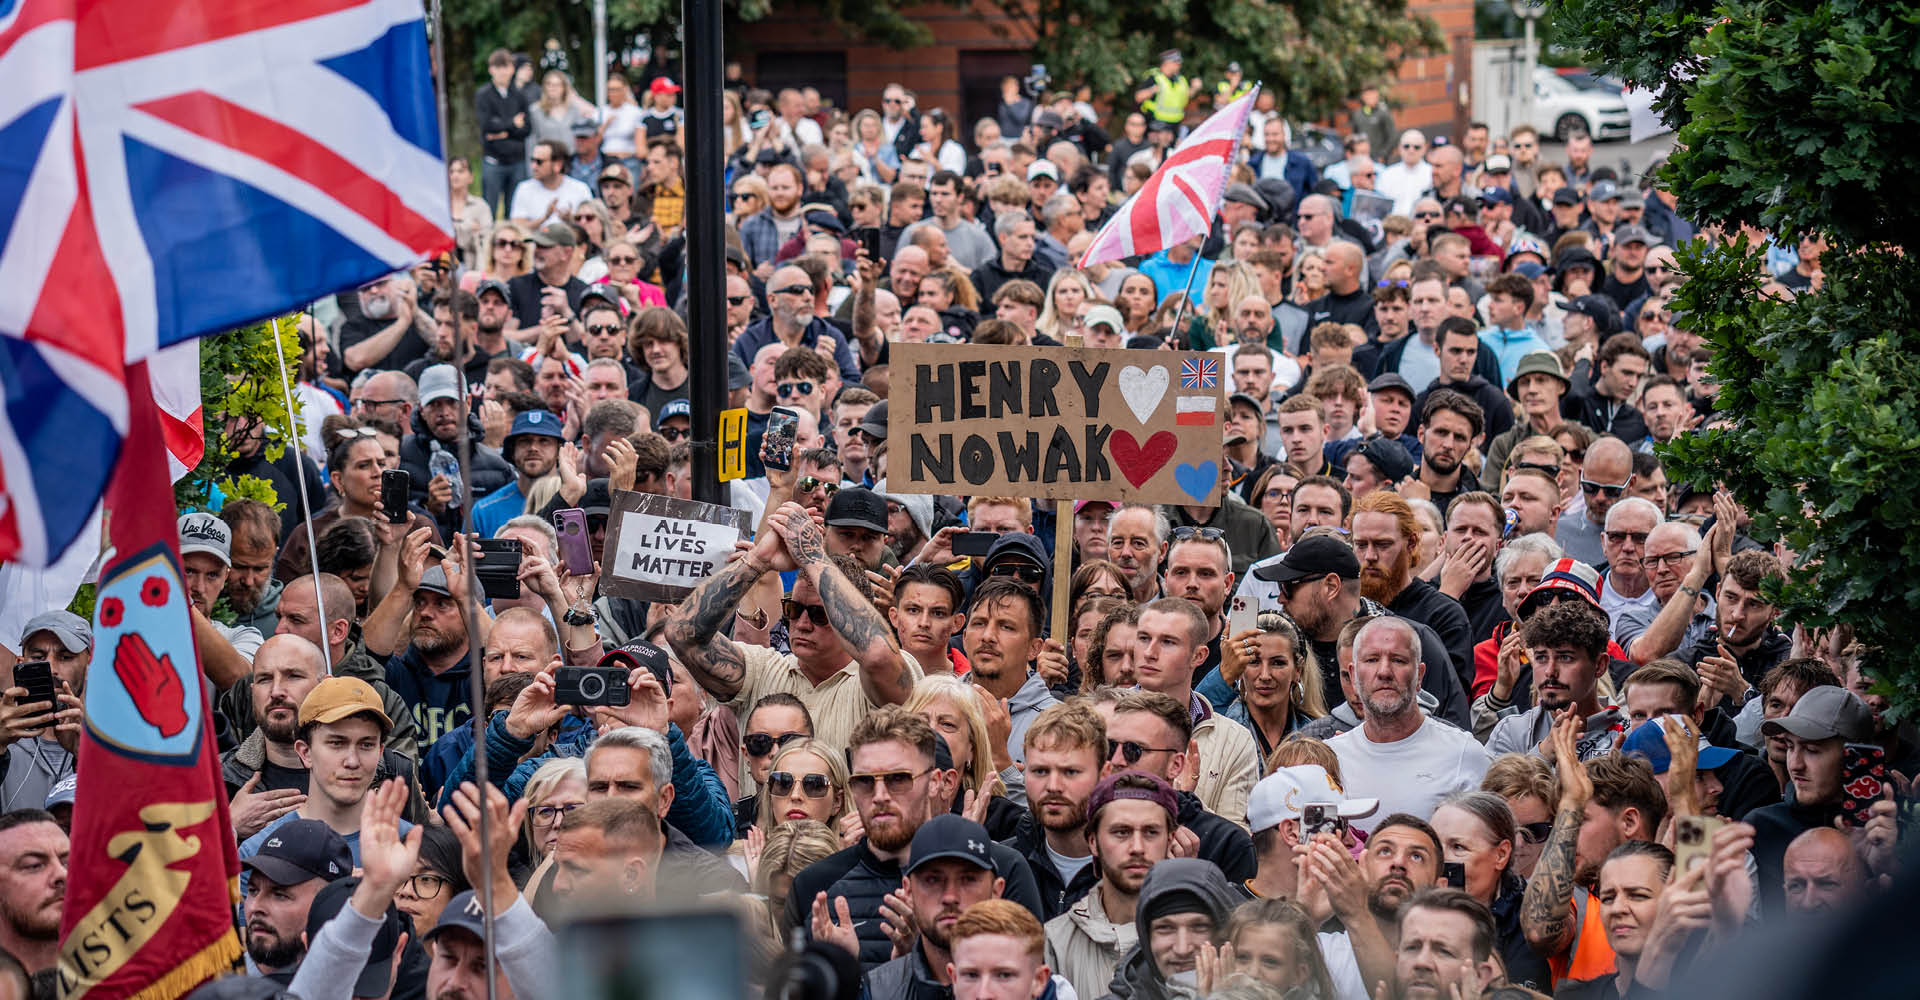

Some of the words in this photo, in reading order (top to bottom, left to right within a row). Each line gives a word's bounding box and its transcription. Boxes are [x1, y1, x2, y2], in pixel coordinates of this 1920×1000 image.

[915, 358, 1111, 424] HENRY
[722, 415, 743, 473] H
[910, 424, 1113, 486] NOWAK
[181, 518, 200, 535] Las
[201, 519, 226, 542] Vegas
[654, 519, 697, 537] ALL
[640, 534, 706, 555] LIVES
[631, 552, 714, 578] MATTER
